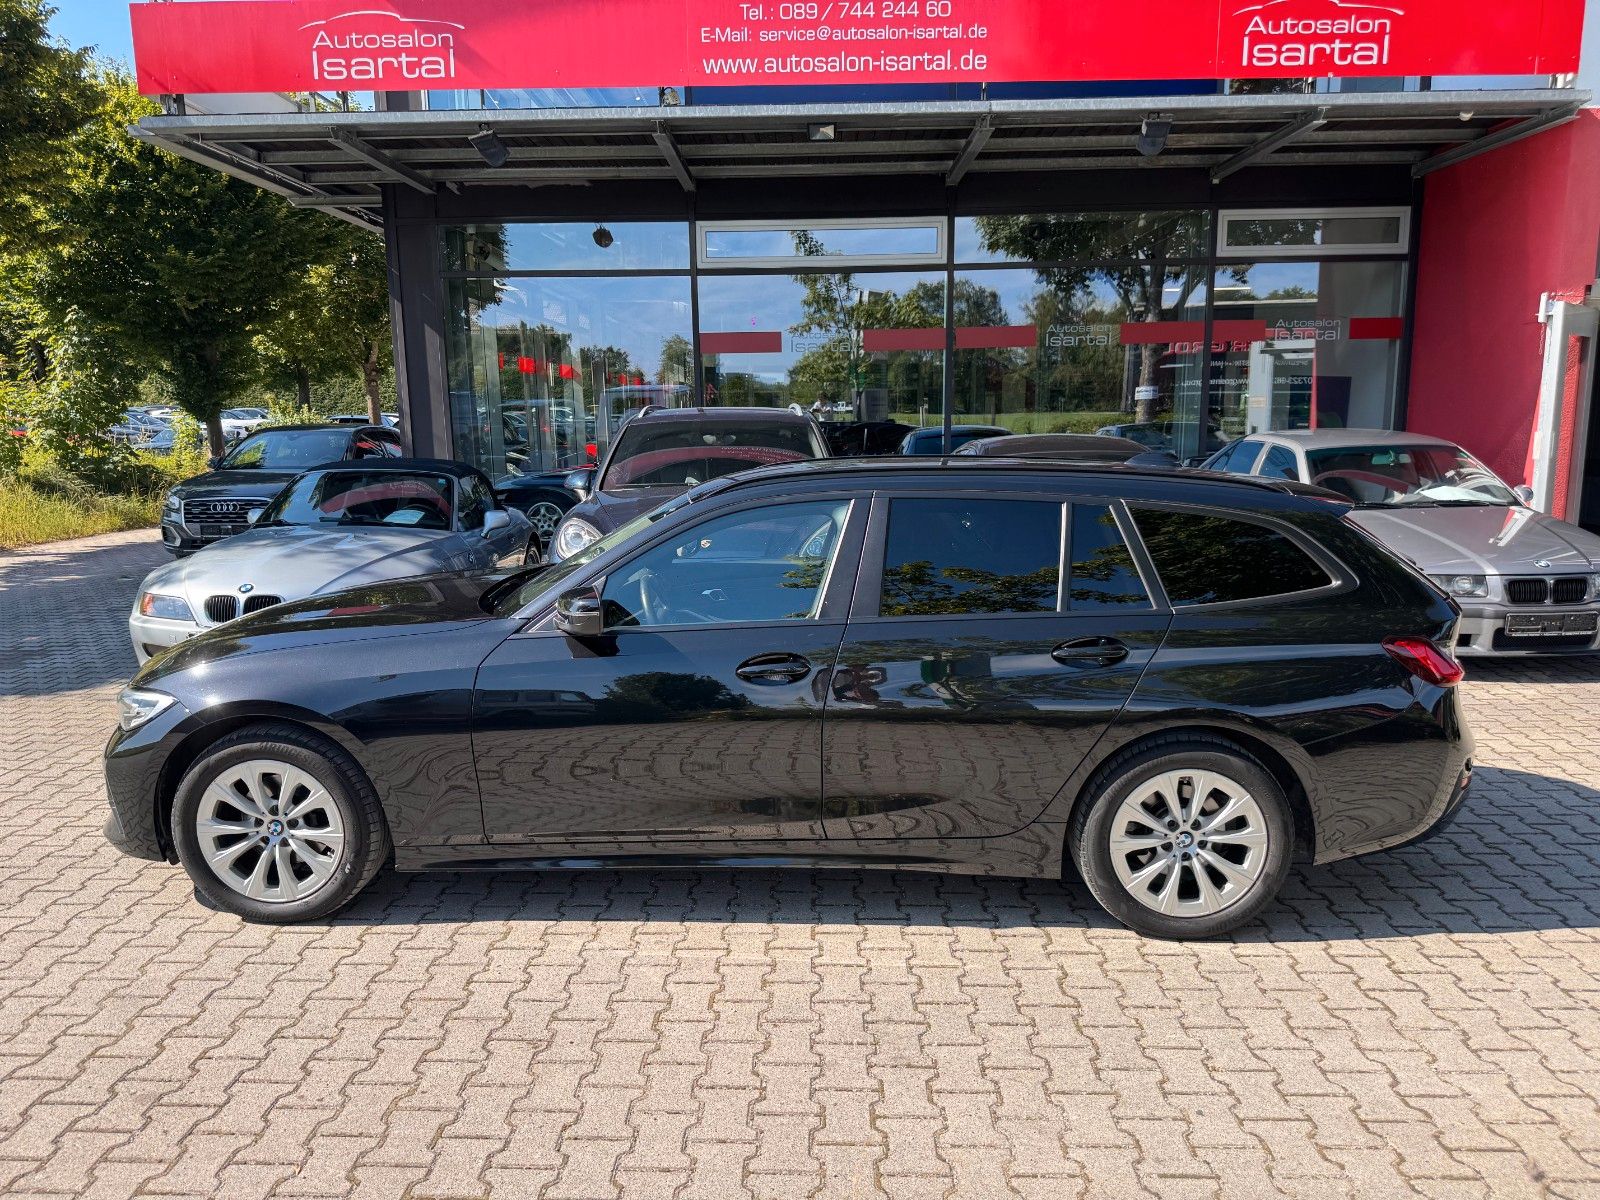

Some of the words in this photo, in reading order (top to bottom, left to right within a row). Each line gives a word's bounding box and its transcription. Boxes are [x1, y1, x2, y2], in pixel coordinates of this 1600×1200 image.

[739, 4, 774, 20] Tel.:
[882, 1, 920, 18] 244
[926, 0, 952, 17] 60
[701, 27, 753, 43] E-Mail:
[759, 23, 988, 42] service@autosalon-isartal.de
[1244, 14, 1391, 35] Autosalon
[312, 29, 454, 49] Autosalon
[1241, 34, 1391, 67] Isartal
[312, 48, 456, 80] Isartal
[702, 49, 988, 74] www.autosalon-isartal.de
[1047, 323, 1112, 333] Autosalon
[1275, 318, 1341, 329] Autosalon
[1045, 332, 1112, 347] Isartal
[1274, 327, 1341, 341] Isartal
